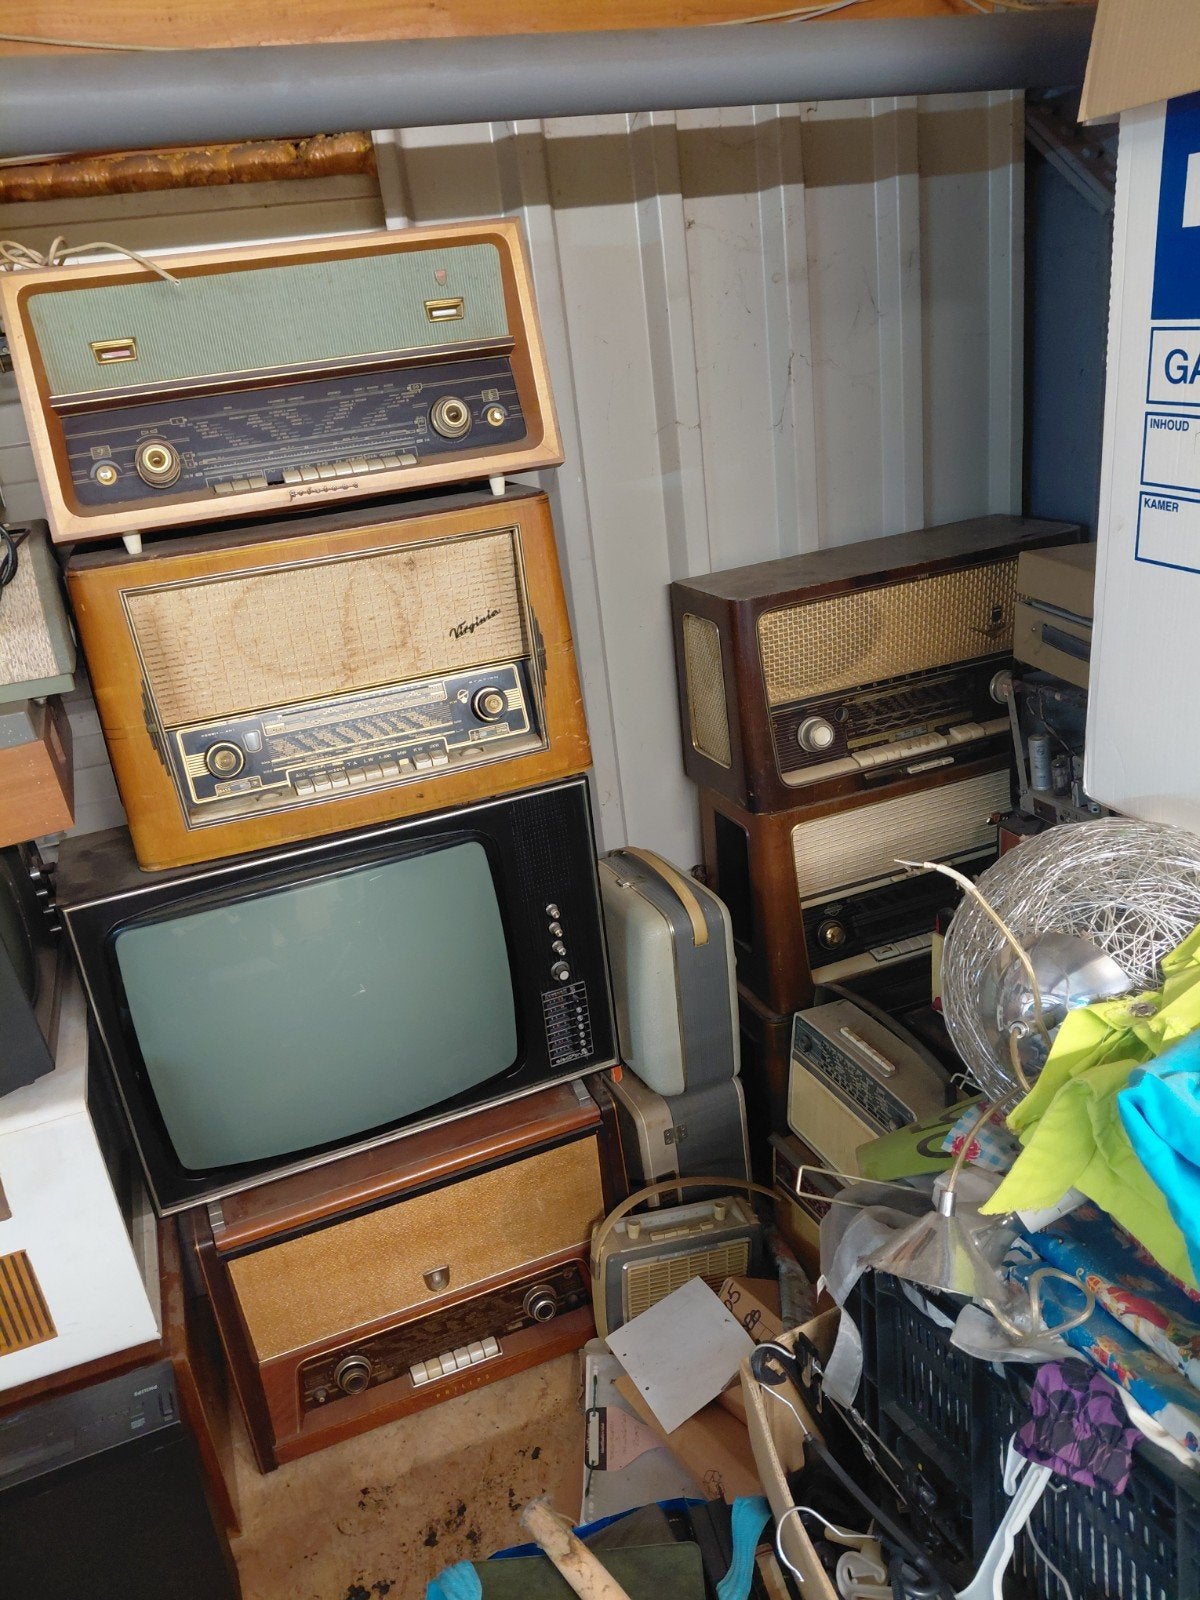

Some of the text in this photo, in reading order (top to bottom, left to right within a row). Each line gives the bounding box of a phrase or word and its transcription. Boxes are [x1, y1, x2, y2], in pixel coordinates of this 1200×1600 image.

[1150, 418, 1190, 432] INHOUD
[1144, 497, 1180, 513] KAMER
[449, 608, 501, 639] Virginia
[436, 1373, 490, 1398] PHILIPS
